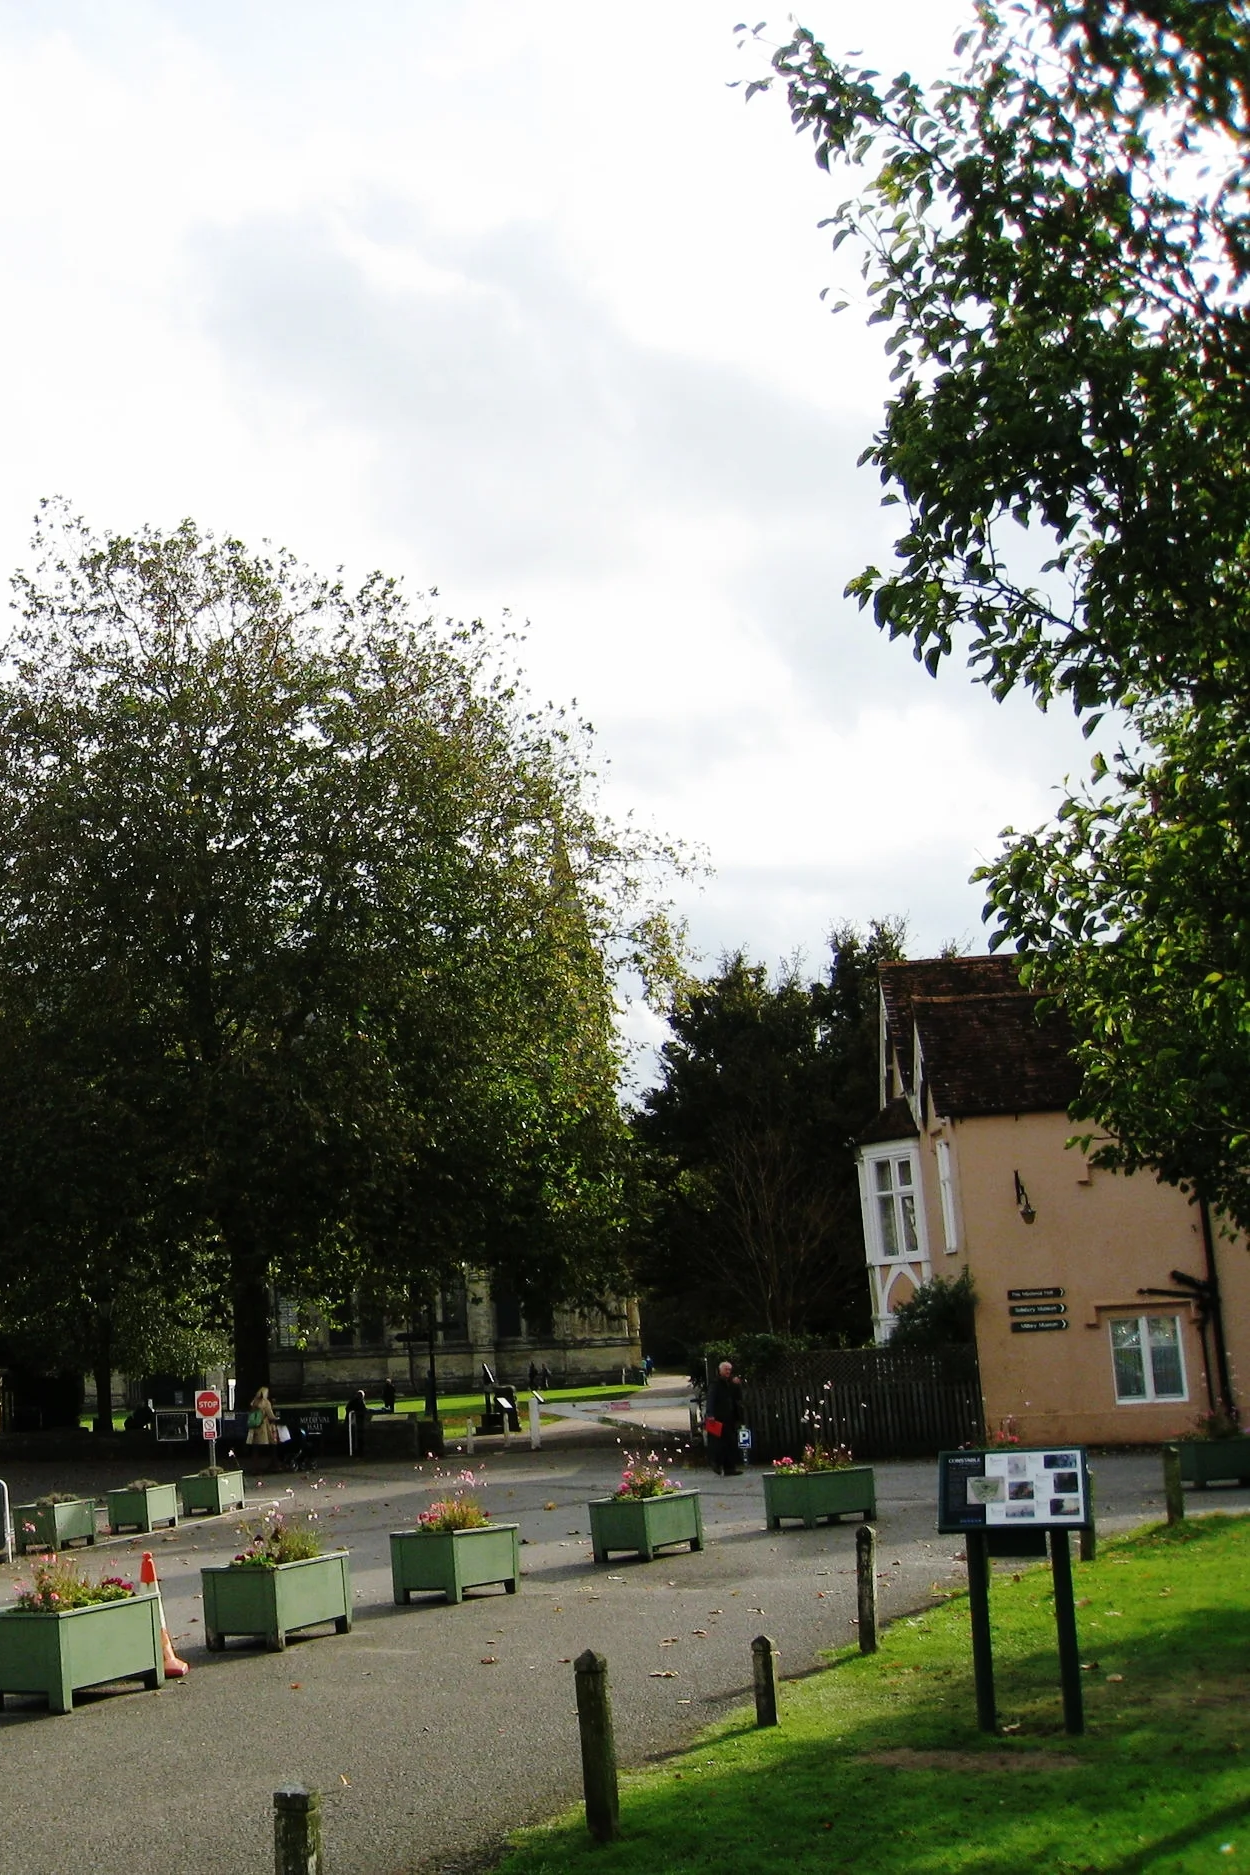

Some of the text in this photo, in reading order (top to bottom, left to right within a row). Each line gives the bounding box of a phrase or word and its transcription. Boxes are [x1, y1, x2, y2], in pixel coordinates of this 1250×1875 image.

[199, 1401, 218, 1409] STOP
[300, 1416, 330, 1424] MEDIEVAL
[740, 1431, 749, 1443] P
